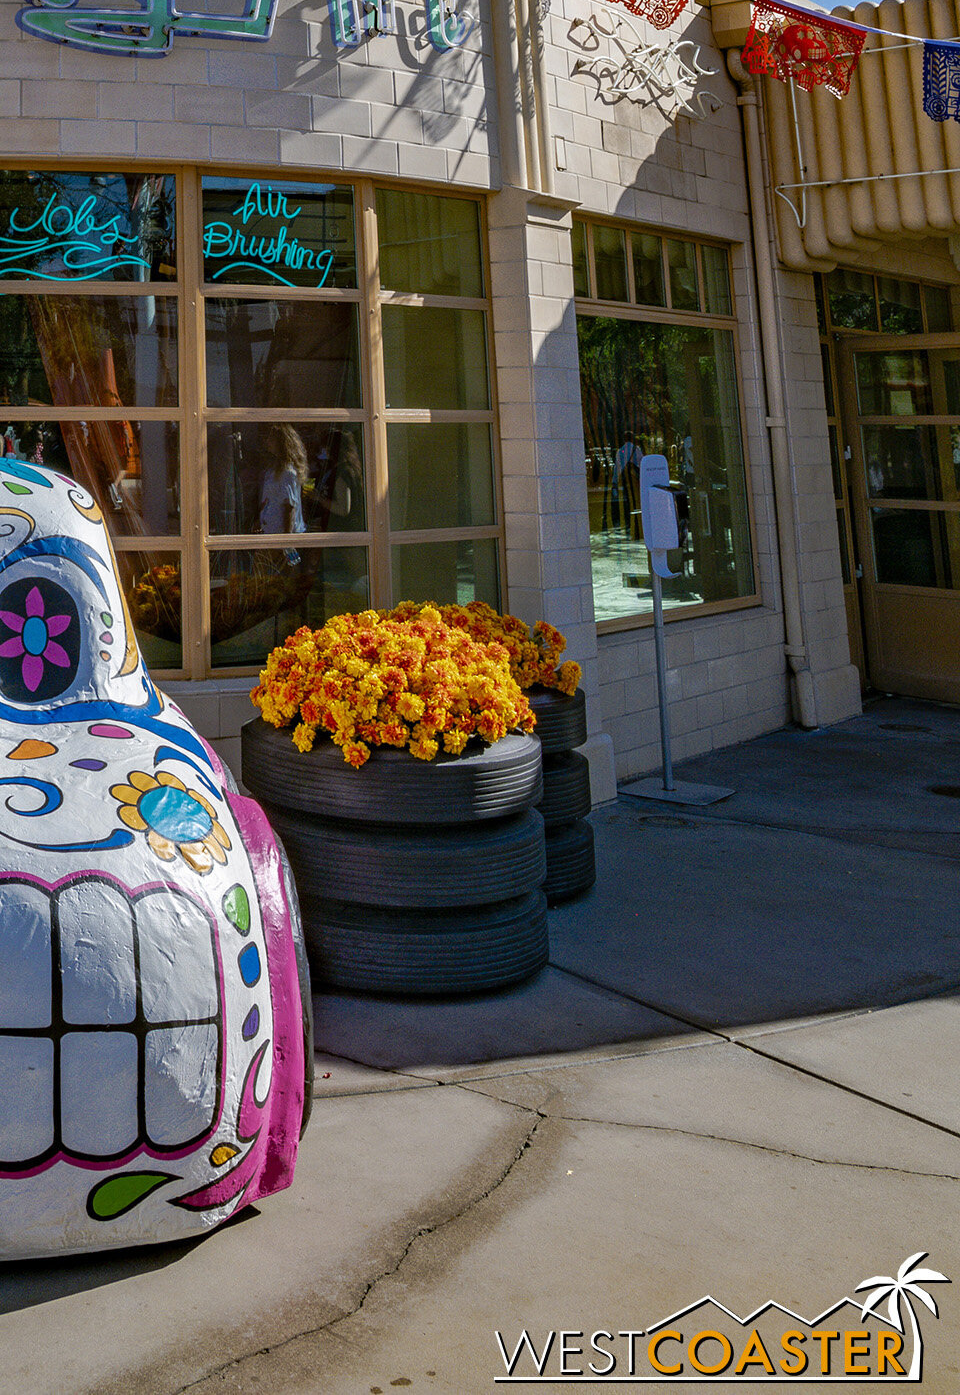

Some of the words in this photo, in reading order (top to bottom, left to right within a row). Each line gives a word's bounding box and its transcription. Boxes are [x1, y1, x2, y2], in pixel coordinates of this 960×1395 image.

[10, 192, 139, 244] Jobs
[233, 182, 302, 225] Air
[203, 221, 333, 289] Brushing
